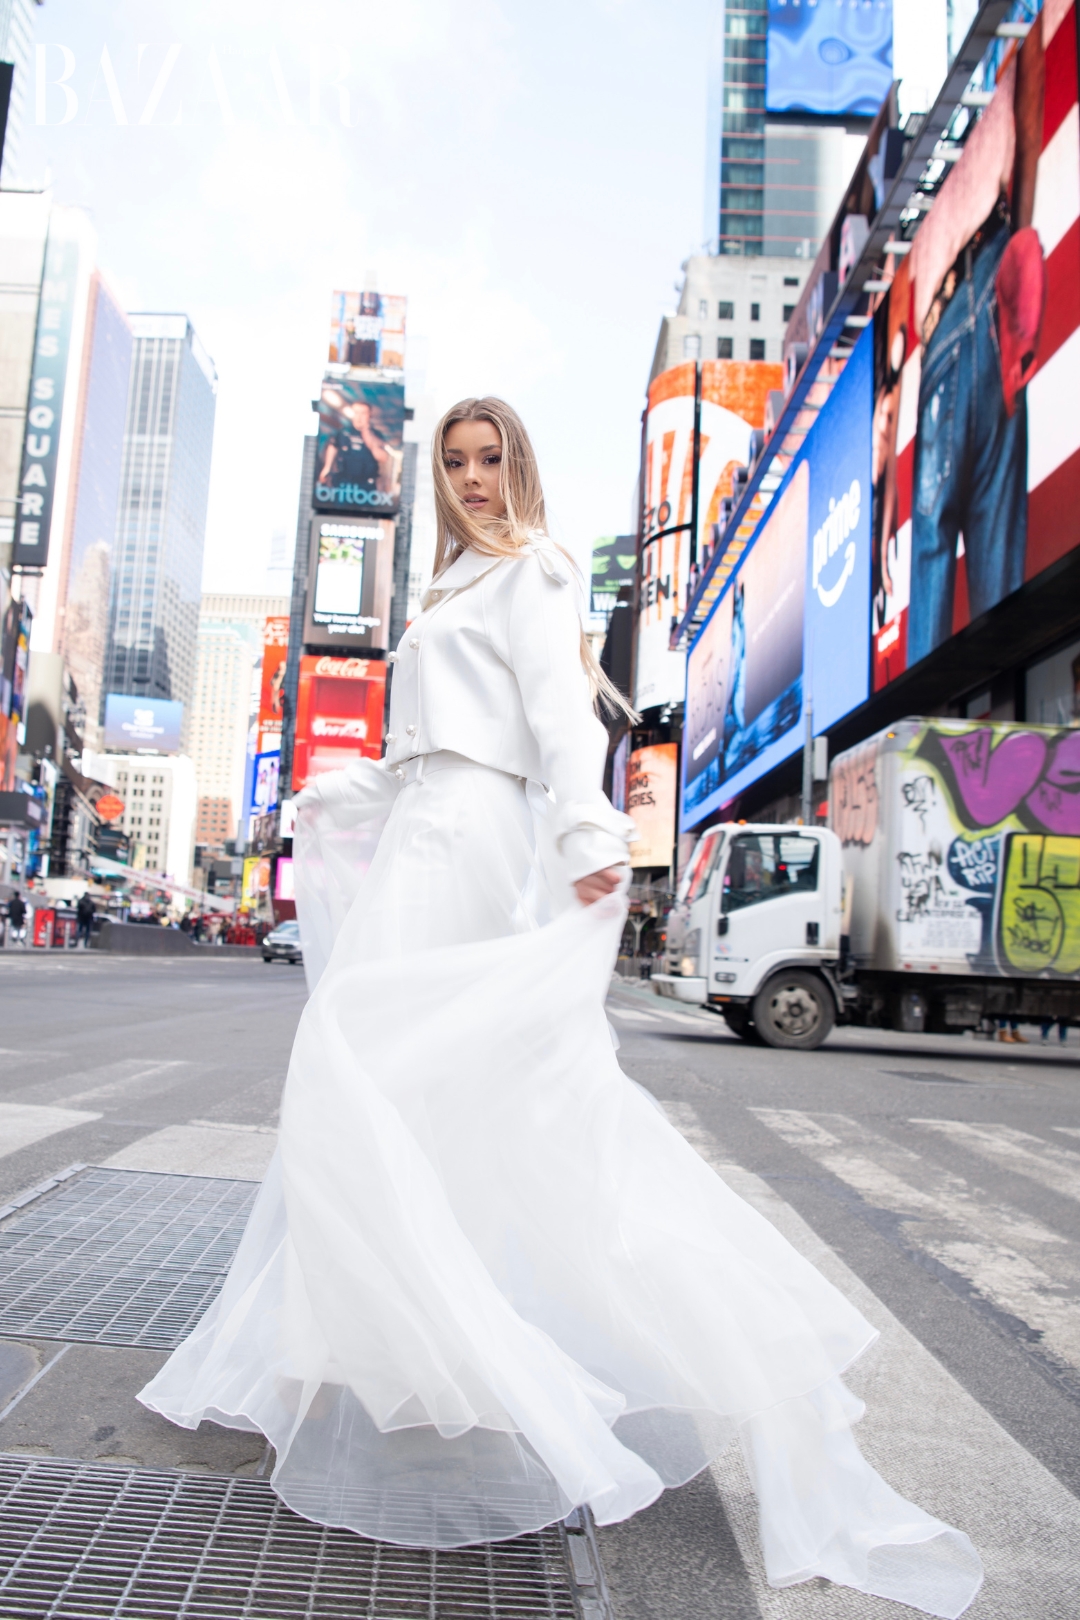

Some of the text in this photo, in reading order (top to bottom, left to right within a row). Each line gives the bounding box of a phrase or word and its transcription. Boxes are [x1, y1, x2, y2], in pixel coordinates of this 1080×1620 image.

[19, 233, 69, 546] IMES SQUARE
[315, 484, 394, 506] britbox
[320, 522, 385, 540] SAMSUNG
[812, 479, 861, 590] prime
